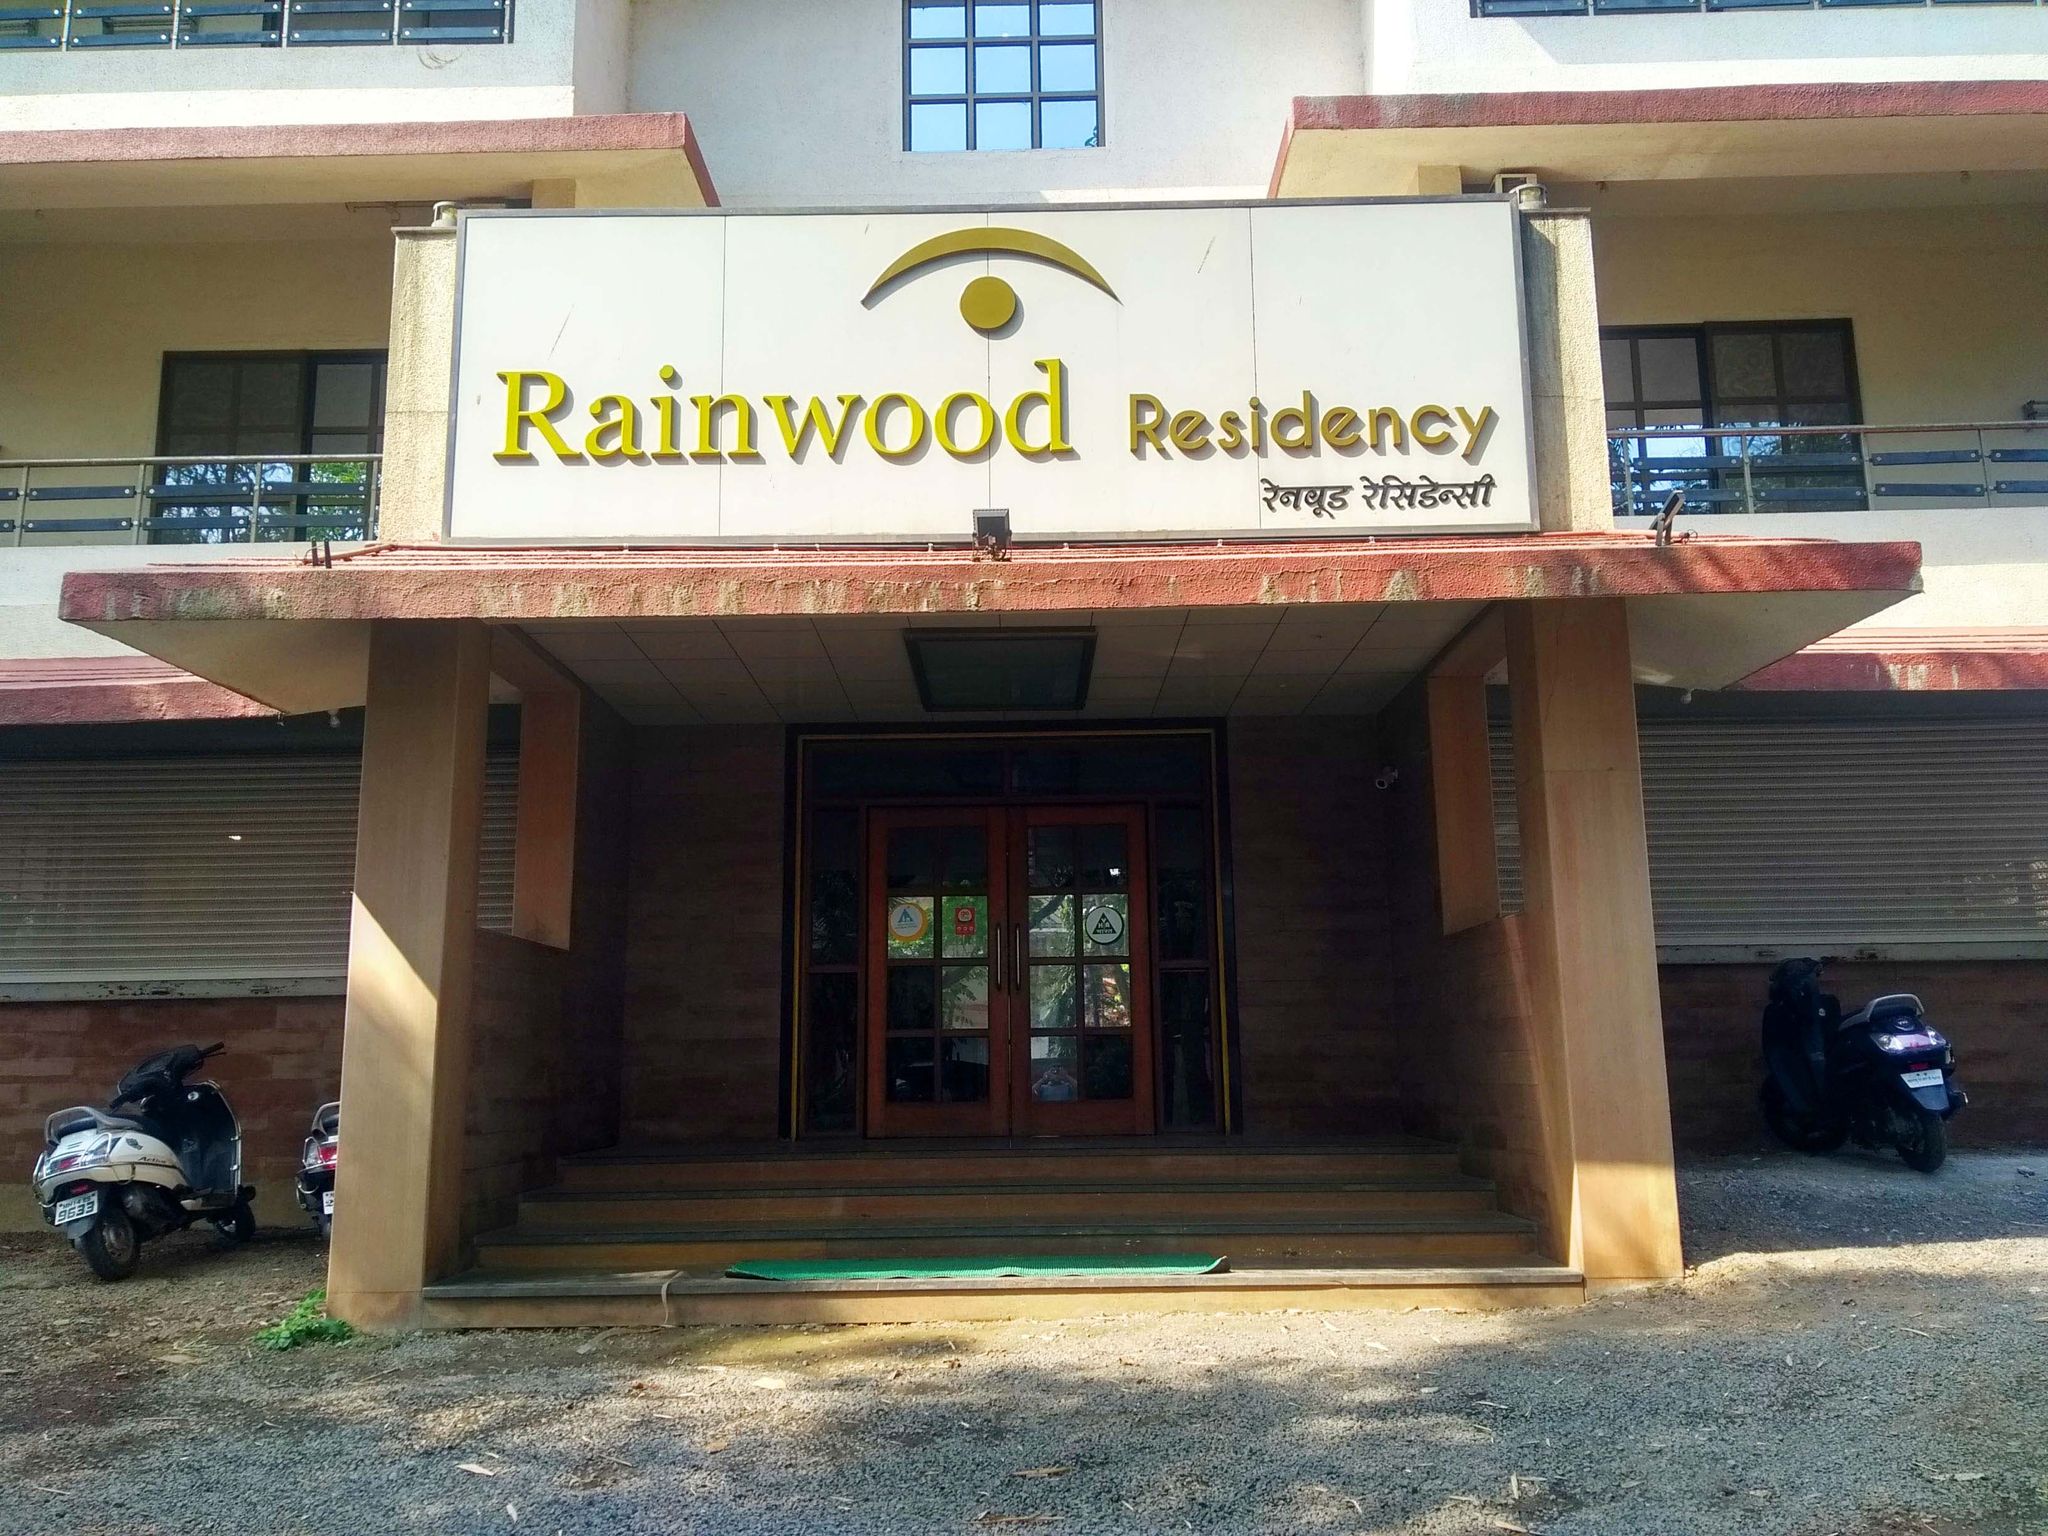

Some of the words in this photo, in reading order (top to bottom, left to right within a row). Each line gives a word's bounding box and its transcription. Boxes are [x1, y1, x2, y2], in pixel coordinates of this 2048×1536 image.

[493, 358, 1075, 459] Rainwood
[1129, 389, 1492, 459] Residency
[1360, 473, 1497, 511] रेसिडेन्सी
[57, 1200, 95, 1222] 9633
